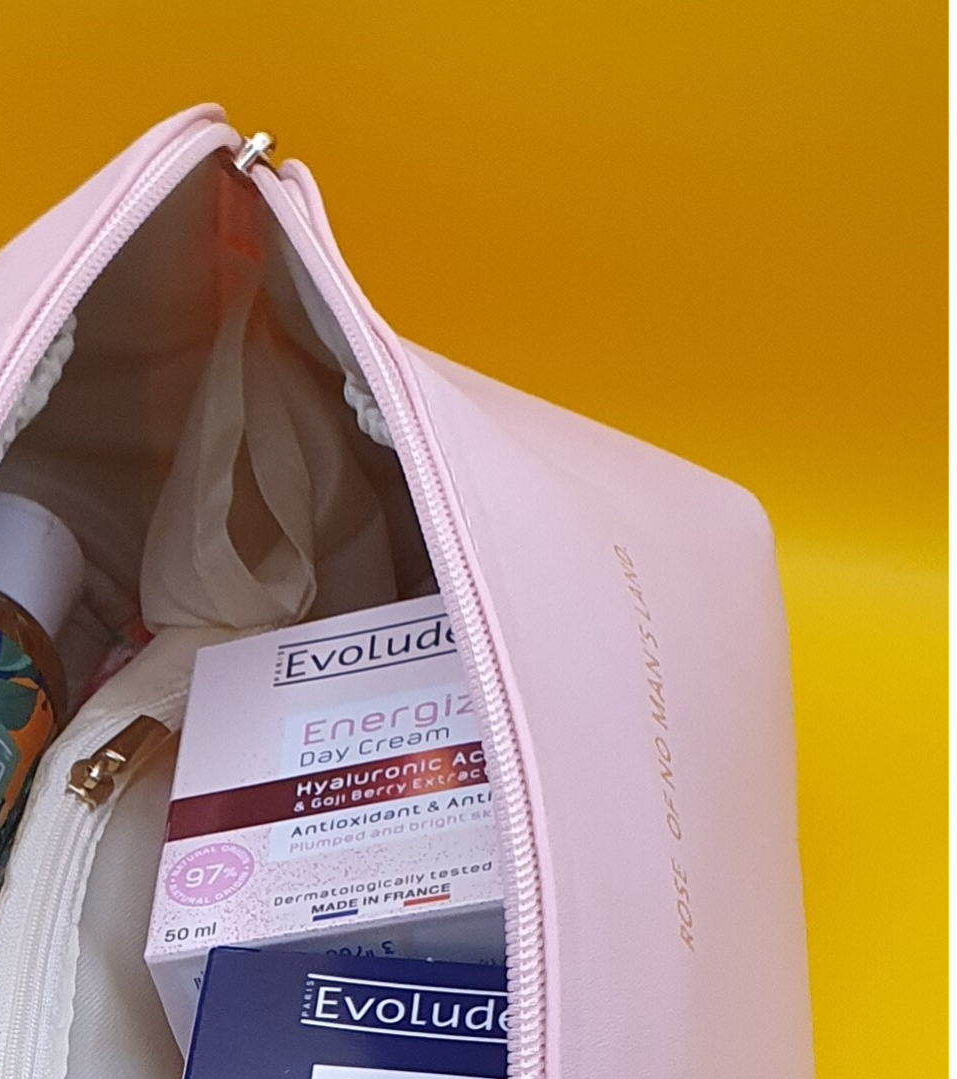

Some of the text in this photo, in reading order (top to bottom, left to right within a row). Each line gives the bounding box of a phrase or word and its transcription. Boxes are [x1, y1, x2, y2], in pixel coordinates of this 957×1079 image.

[302, 693, 476, 747] Energiz
[300, 727, 450, 768] Day Cream
[296, 756, 443, 797] Hyaluronic
[293, 800, 305, 812] &
[310, 793, 346, 811] Goji
[351, 781, 407, 802] Berry
[289, 831, 365, 854] Plumped
[369, 824, 404, 839] and
[408, 813, 466, 832] bright
[290, 804, 421, 838] Antioxidant
[426, 800, 440, 813] &
[274, 861, 494, 907] Dermatologically tested
[310, 882, 452, 915] MADE IN FRANCE
[164, 922, 217, 944] 50 ml
[301, 980, 316, 1018] PARIS
